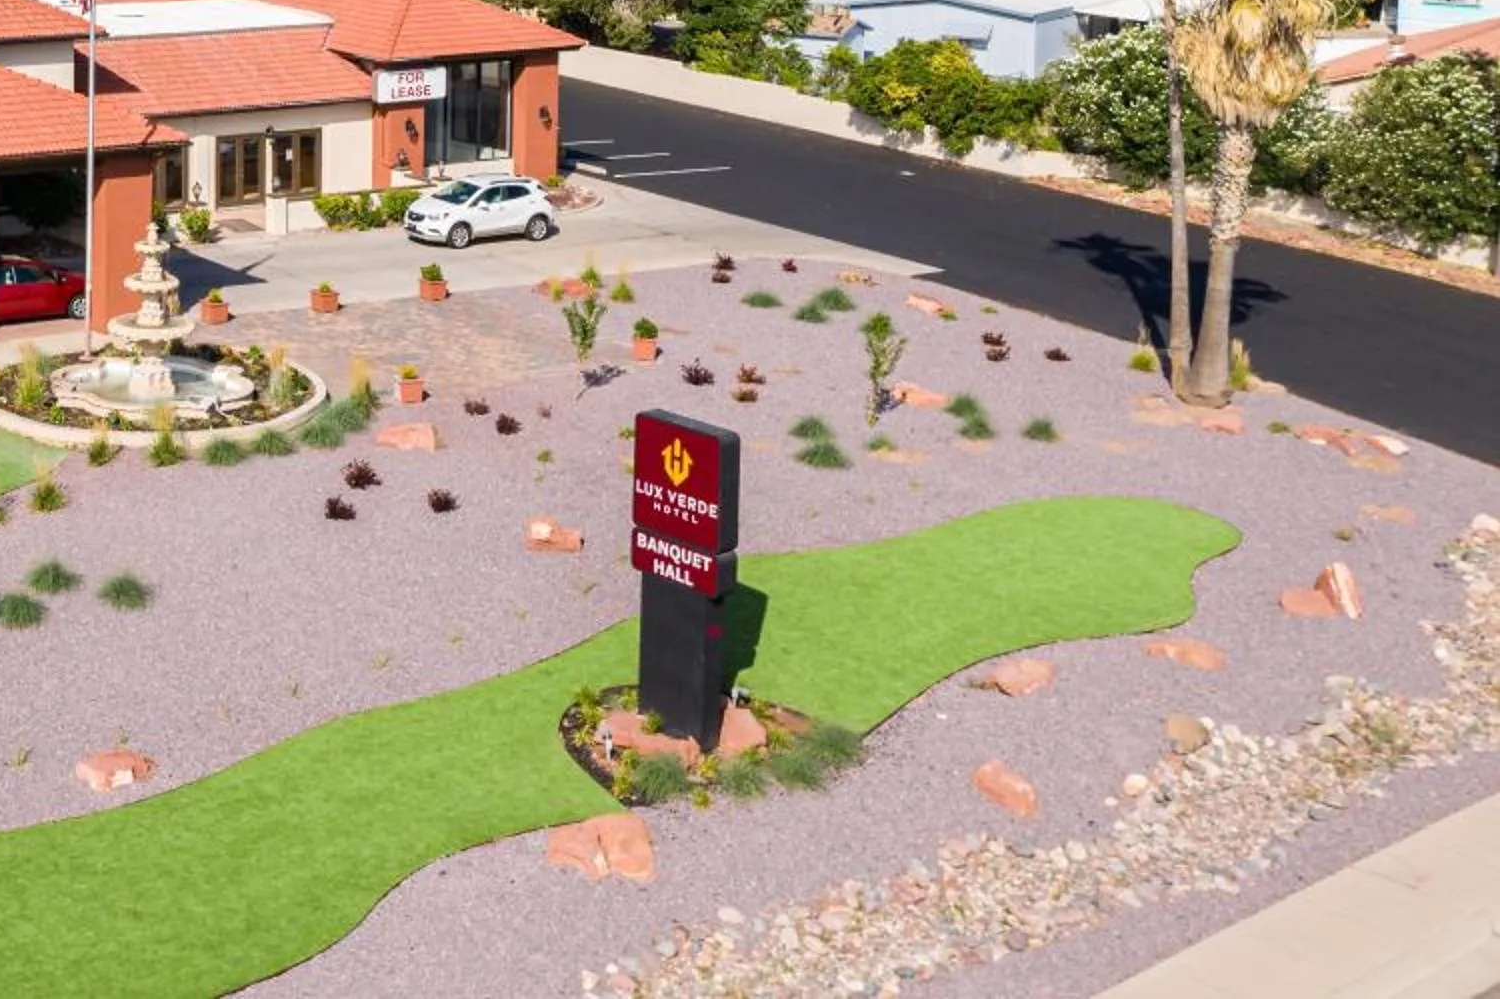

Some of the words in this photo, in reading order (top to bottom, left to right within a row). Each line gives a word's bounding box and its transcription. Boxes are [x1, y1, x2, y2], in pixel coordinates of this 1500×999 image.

[398, 71, 424, 83] FOR
[391, 85, 432, 99] LEASE
[635, 479, 663, 501] LUX
[667, 489, 719, 519] VERDE
[653, 502, 699, 525] HOTEL
[636, 532, 713, 572] BANQUET
[653, 559, 694, 587] HALL
